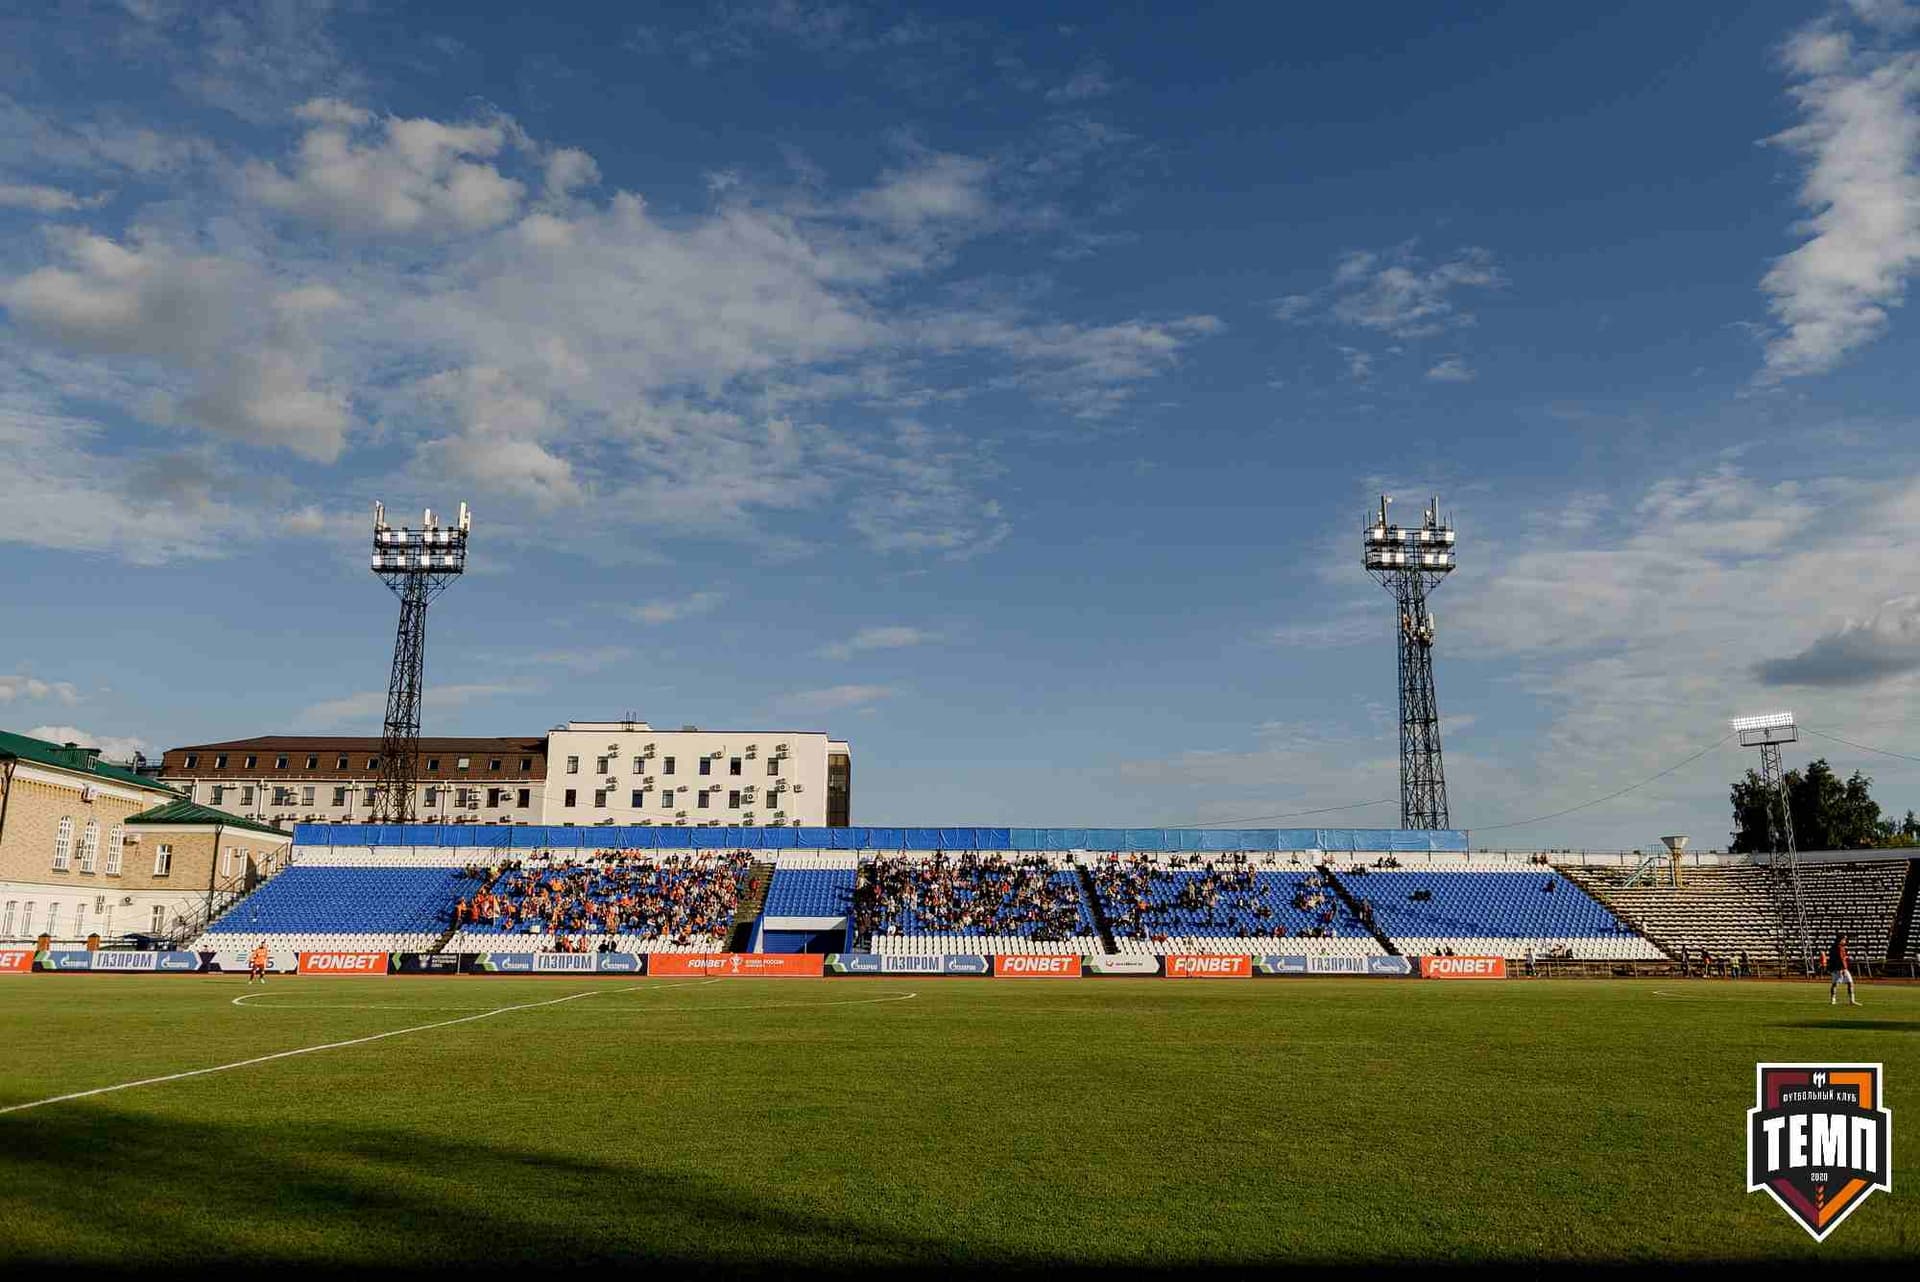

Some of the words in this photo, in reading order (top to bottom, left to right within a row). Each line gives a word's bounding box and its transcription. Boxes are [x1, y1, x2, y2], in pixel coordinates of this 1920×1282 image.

[0, 953, 26, 967] ET
[97, 953, 151, 968] ГАЗПРОМ
[307, 955, 380, 969] FONBET
[539, 954, 592, 969] ГАЗПРОМ
[688, 959, 727, 968] FONBET
[886, 956, 939, 970] ГАЗПРОМ
[1003, 957, 1072, 972] FONBET
[1174, 958, 1243, 972] FONBET
[1311, 957, 1364, 971] ГАЗПРОМ
[1429, 959, 1497, 973] FONBET
